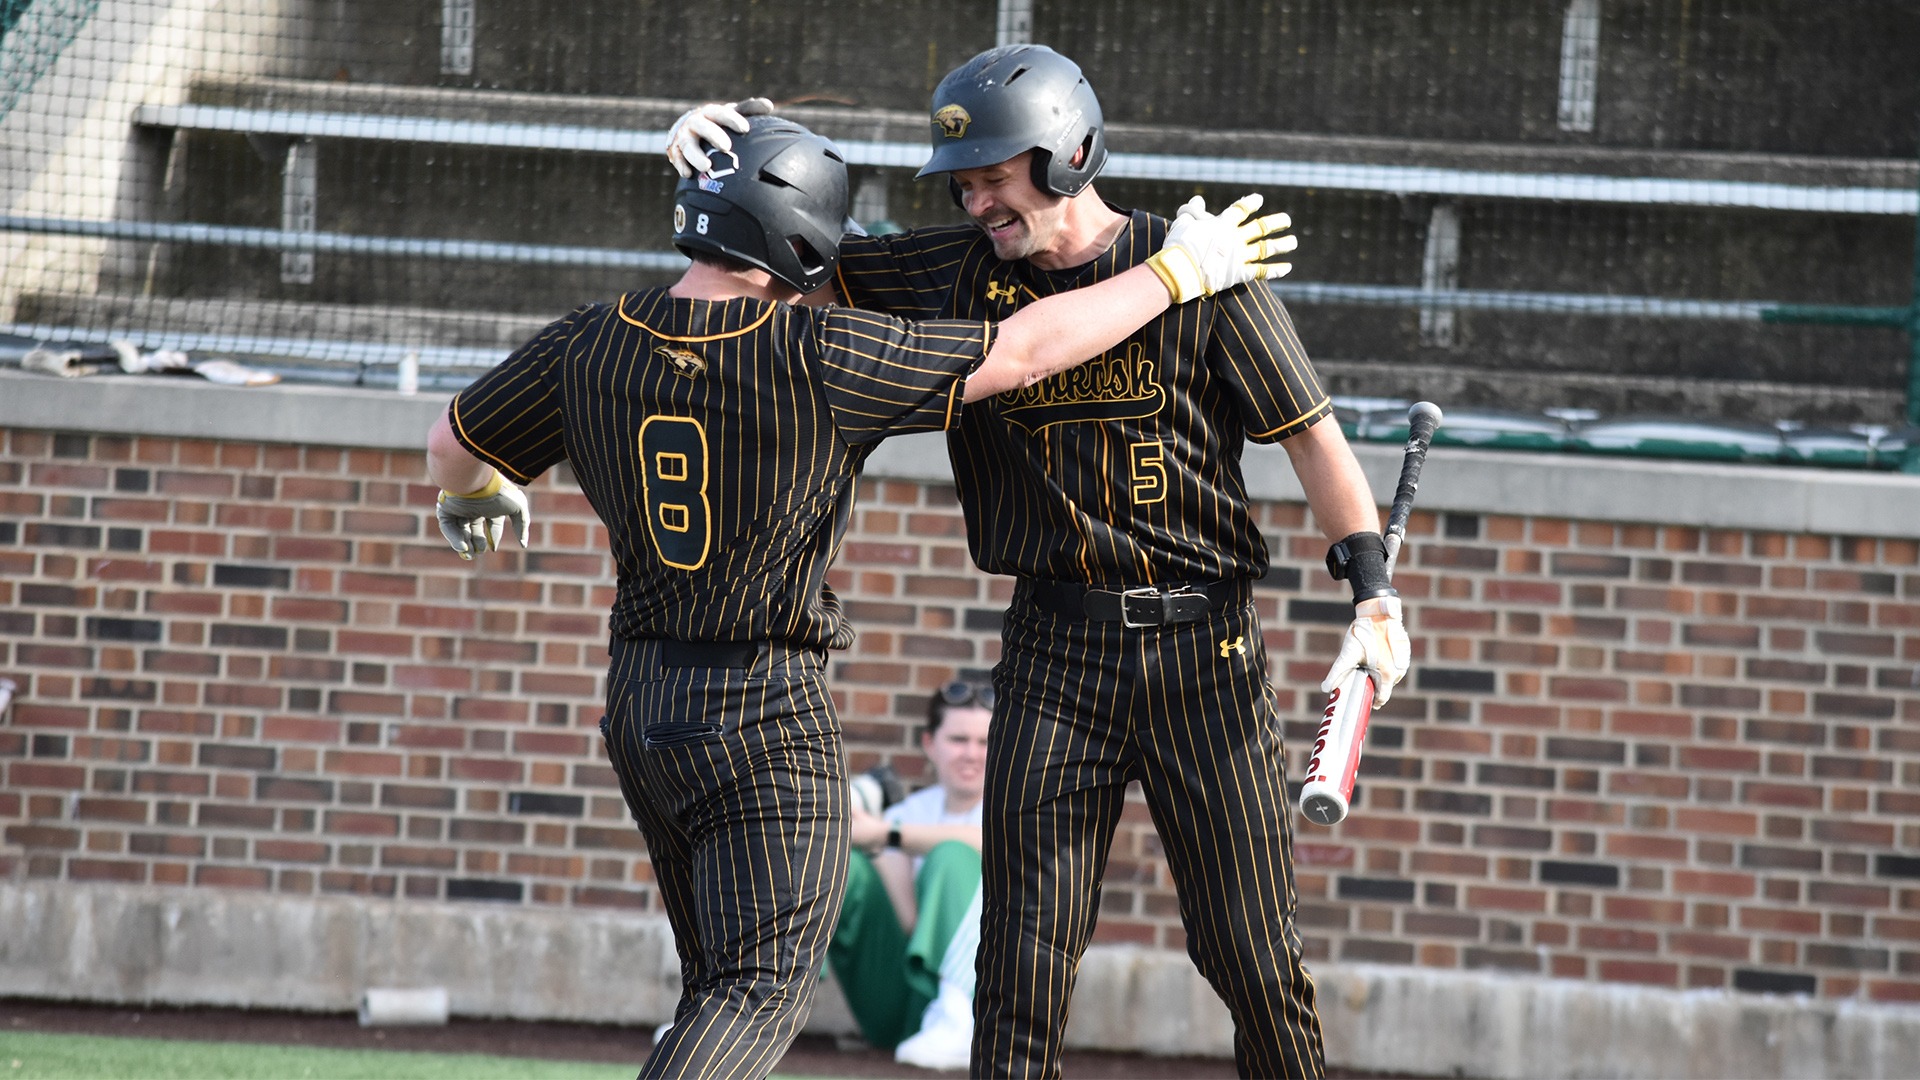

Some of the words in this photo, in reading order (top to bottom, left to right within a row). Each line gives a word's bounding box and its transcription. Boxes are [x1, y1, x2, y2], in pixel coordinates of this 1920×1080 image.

[696, 213, 709, 235] 8
[997, 342, 1156, 405] shkosh
[638, 414, 711, 571] 8
[1130, 441, 1167, 505] 5
